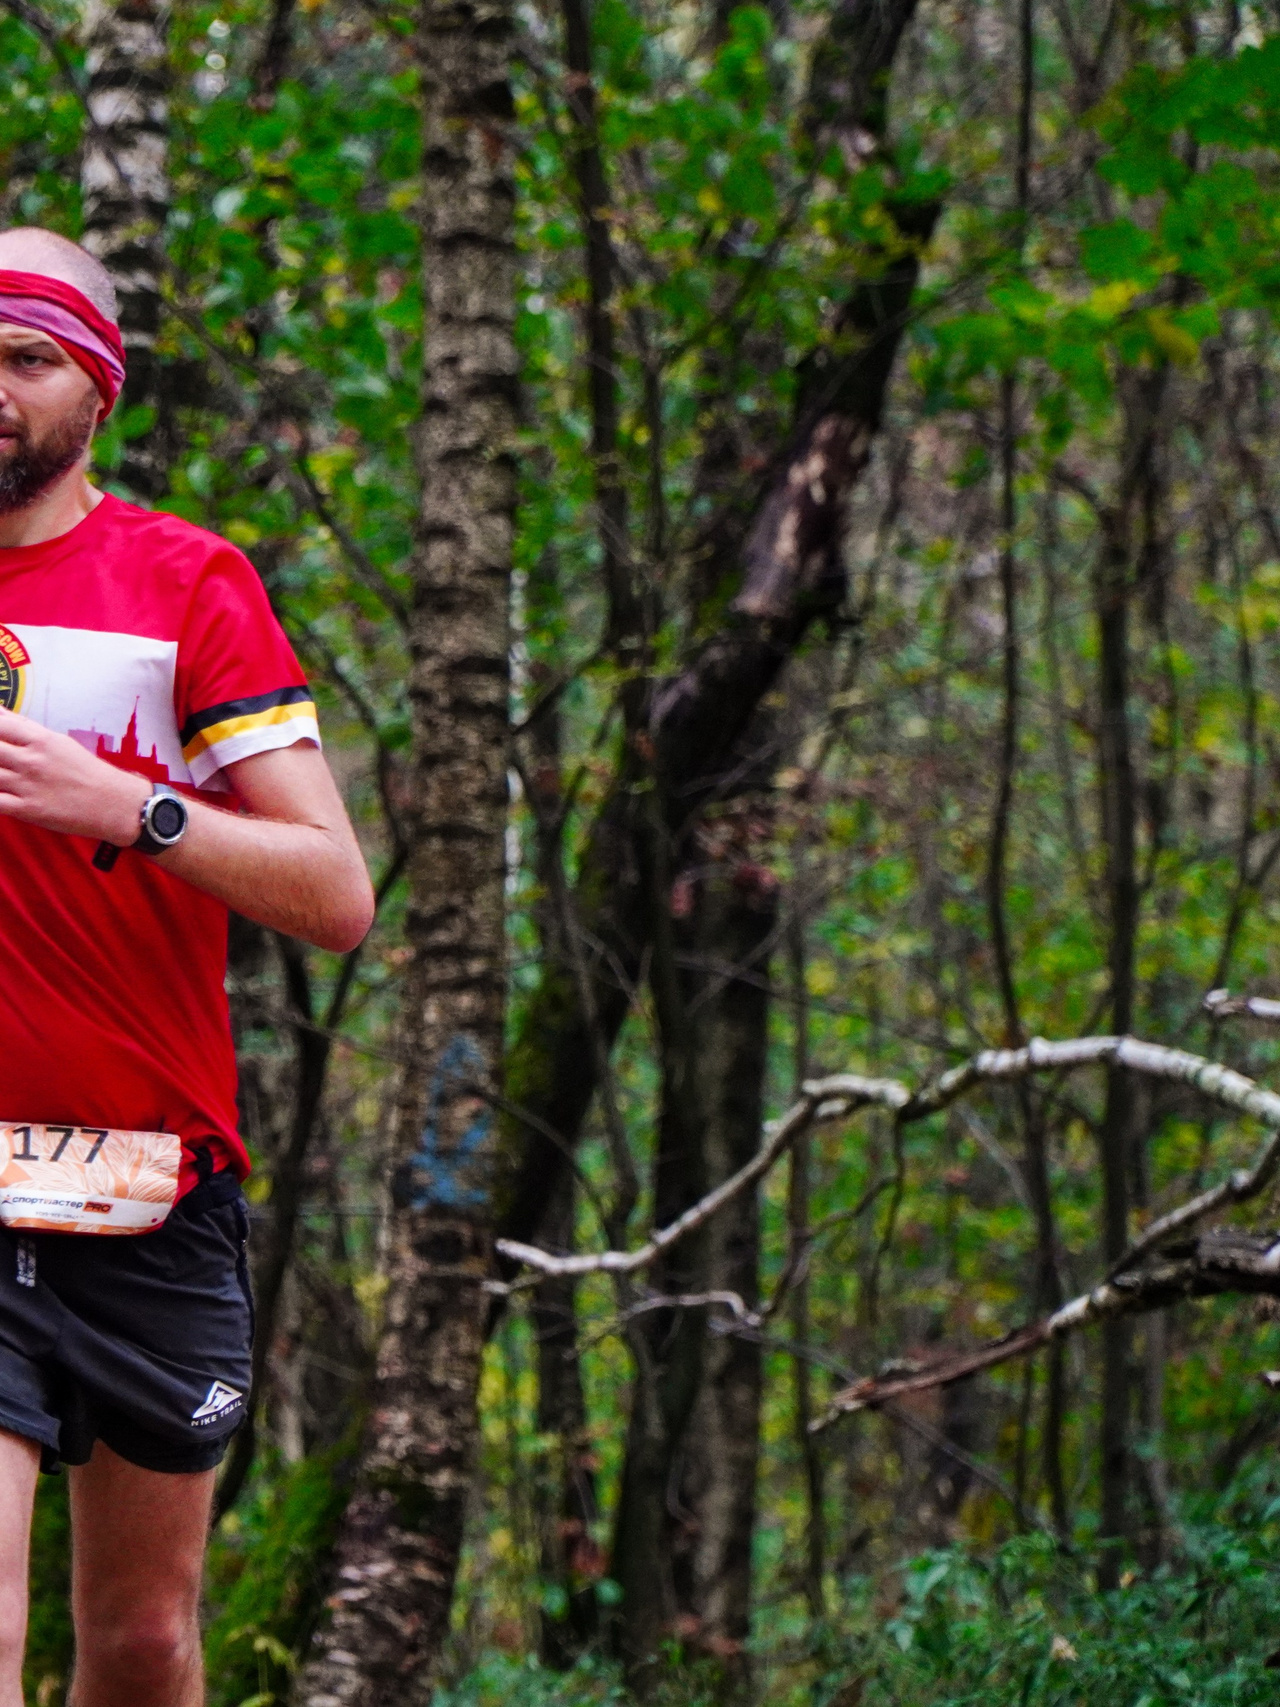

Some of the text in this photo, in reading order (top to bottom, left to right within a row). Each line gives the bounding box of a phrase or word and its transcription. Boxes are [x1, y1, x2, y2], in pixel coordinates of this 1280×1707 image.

[12, 1126, 109, 1163] 177
[84, 1201, 112, 1213] PRO
[191, 1400, 242, 1427] NIKE TRAIL
